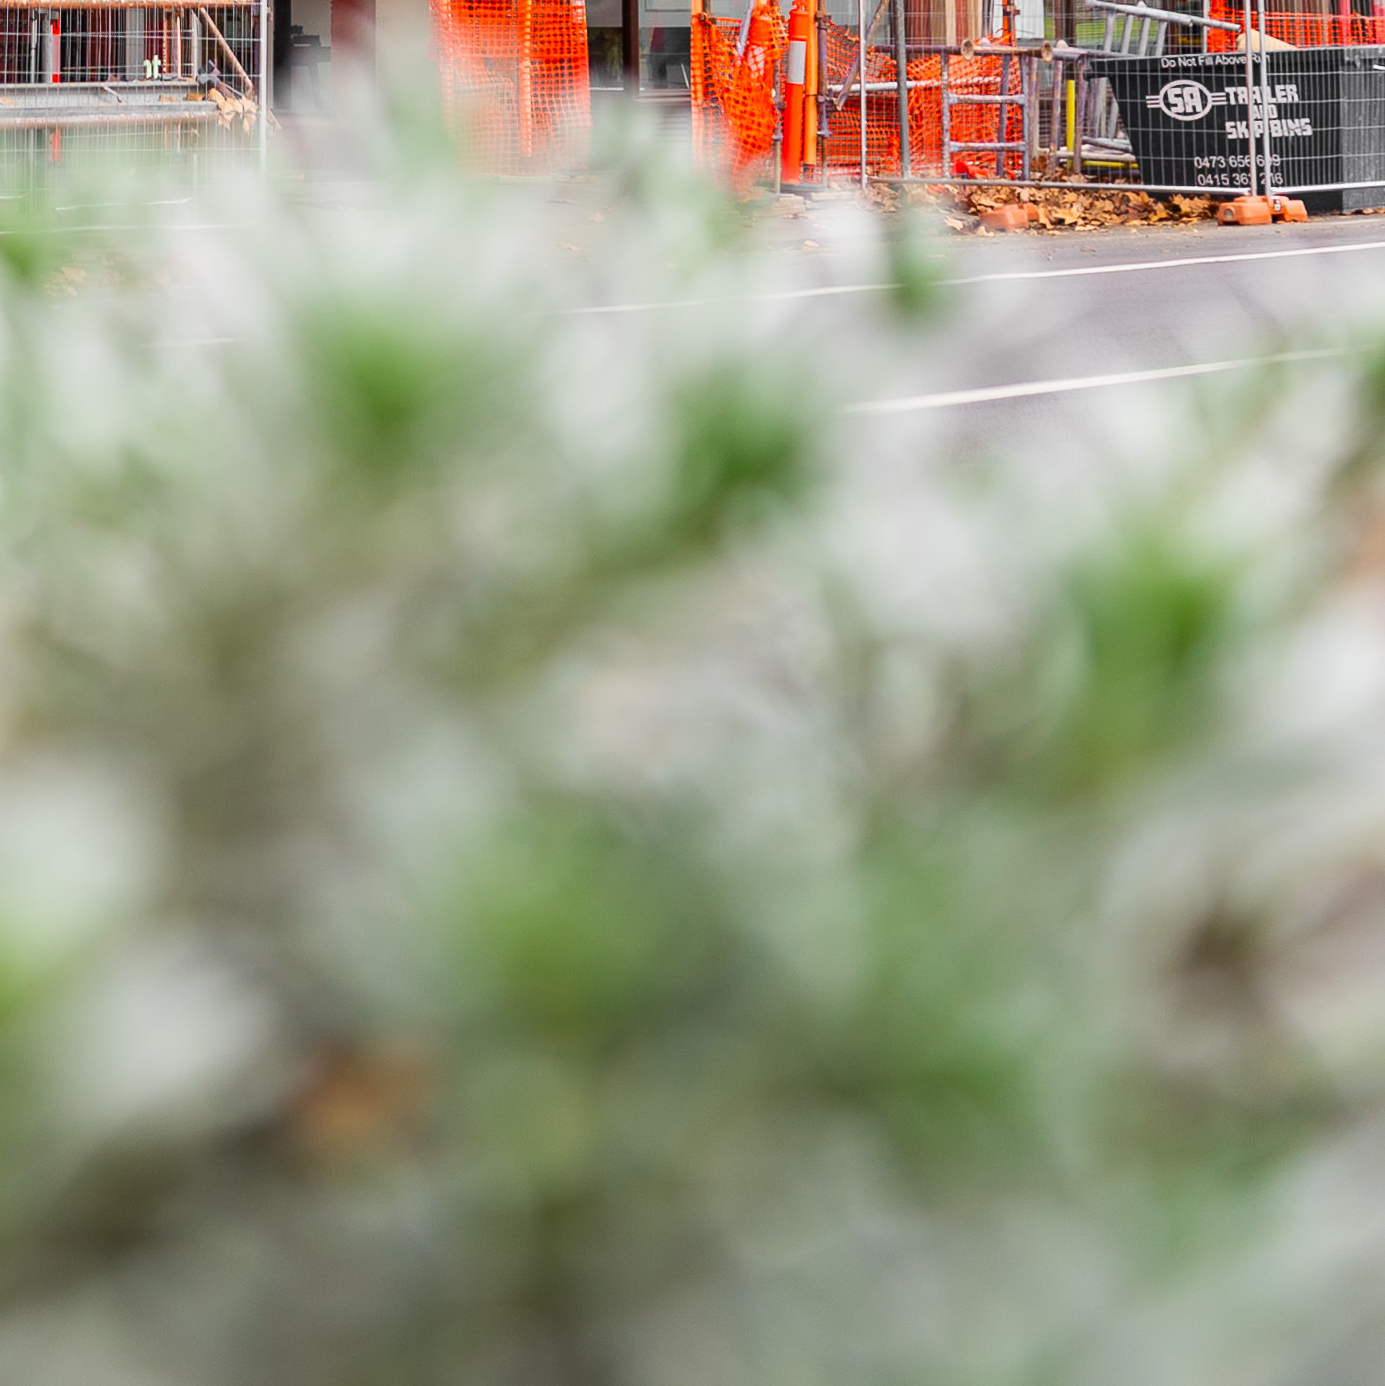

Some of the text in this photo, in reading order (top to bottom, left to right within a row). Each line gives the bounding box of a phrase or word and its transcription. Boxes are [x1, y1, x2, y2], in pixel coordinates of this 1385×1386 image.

[1161, 57, 1176, 68] Do
[1178, 56, 1196, 67] Not
[1215, 54, 1247, 65] Above
[1167, 84, 1299, 113] SA TRALER
[1225, 118, 1313, 139] SKP BINS
[1194, 156, 1226, 168] 0473
[1256, 154, 1281, 167] 69
[1197, 173, 1229, 186] 0415
[1232, 173, 1252, 185] 36
